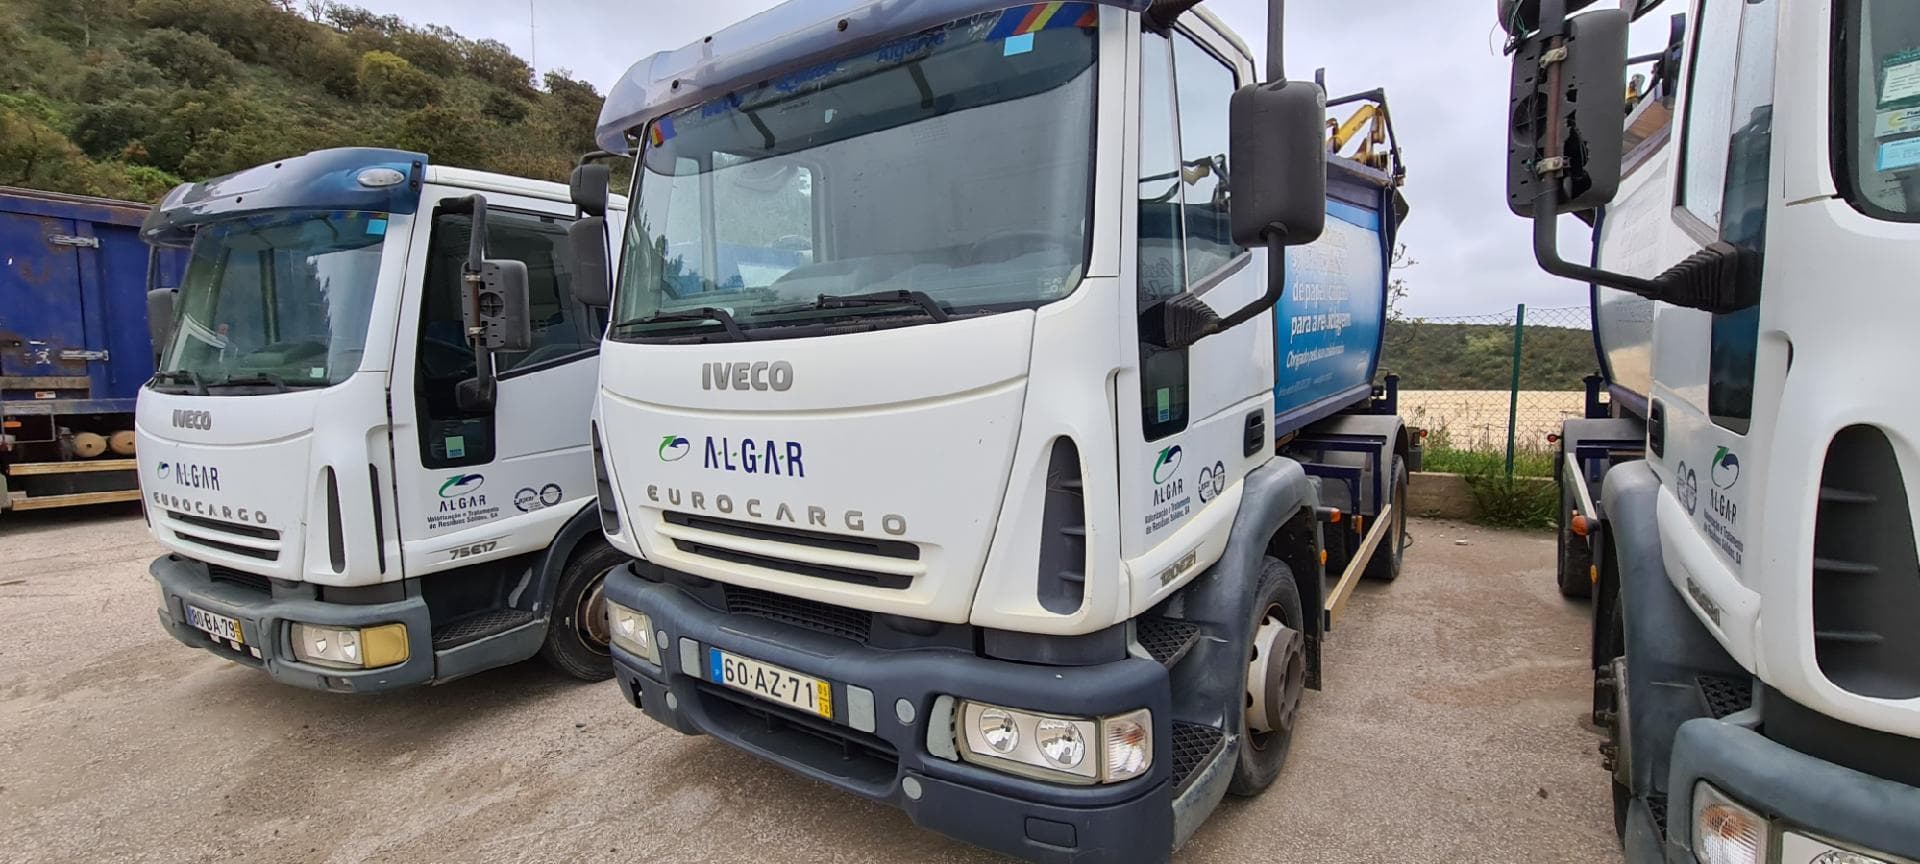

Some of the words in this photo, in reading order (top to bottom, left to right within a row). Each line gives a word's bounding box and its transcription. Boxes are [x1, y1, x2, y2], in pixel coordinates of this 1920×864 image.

[701, 361, 794, 392] IVECO
[172, 408, 212, 430] IVECO
[153, 491, 268, 524] EUROCARGO
[646, 484, 908, 536] EUROCARGO
[449, 541, 497, 560] 75E17
